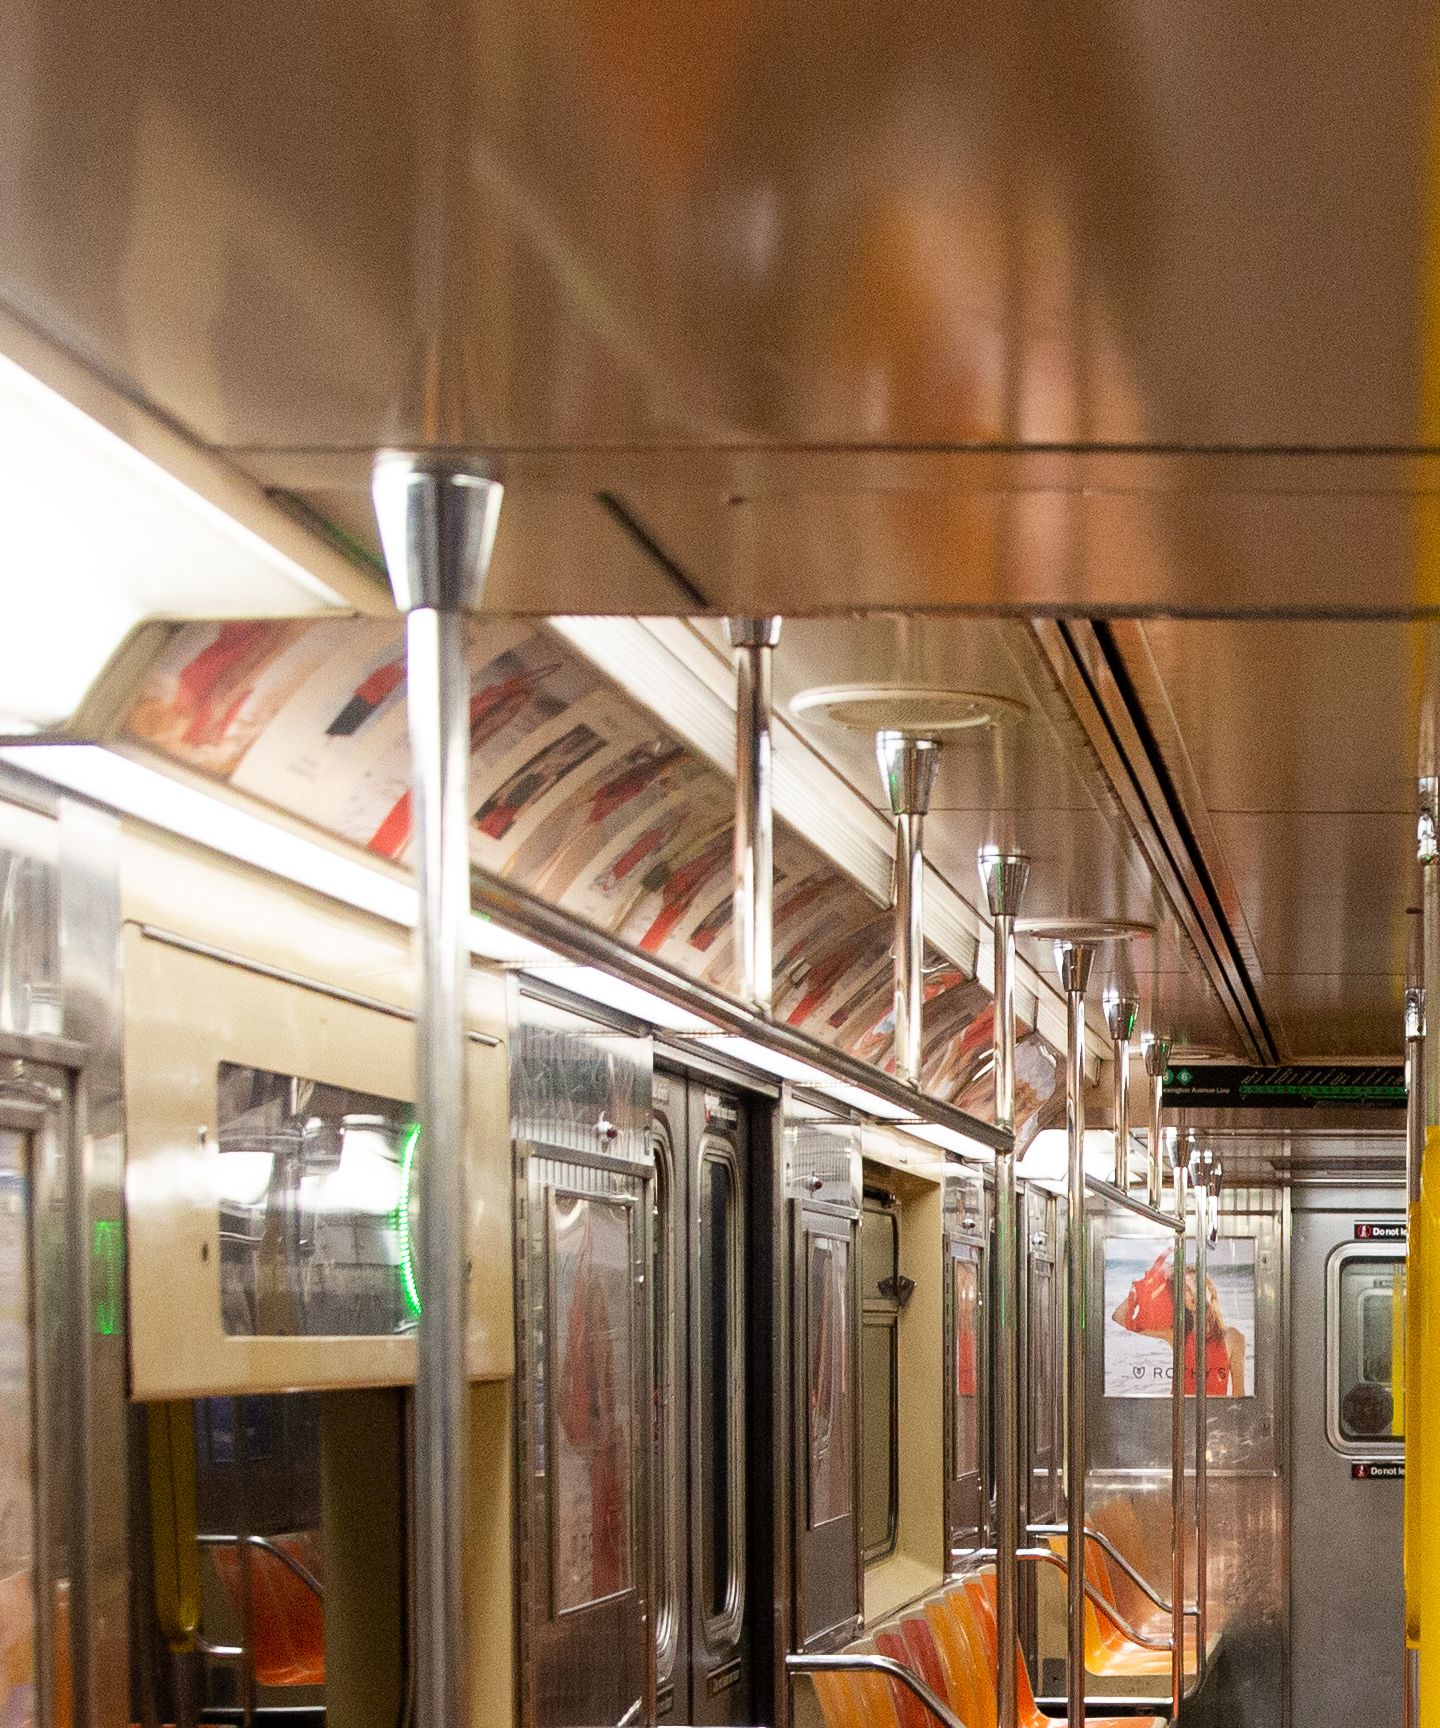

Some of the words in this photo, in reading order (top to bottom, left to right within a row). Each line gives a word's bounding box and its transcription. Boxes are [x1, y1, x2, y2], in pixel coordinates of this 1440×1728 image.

[1372, 1226, 1386, 1237] Do
[1385, 1227, 1400, 1237] not
[1370, 1466, 1383, 1476] Do
[1383, 1467, 1397, 1476] not
